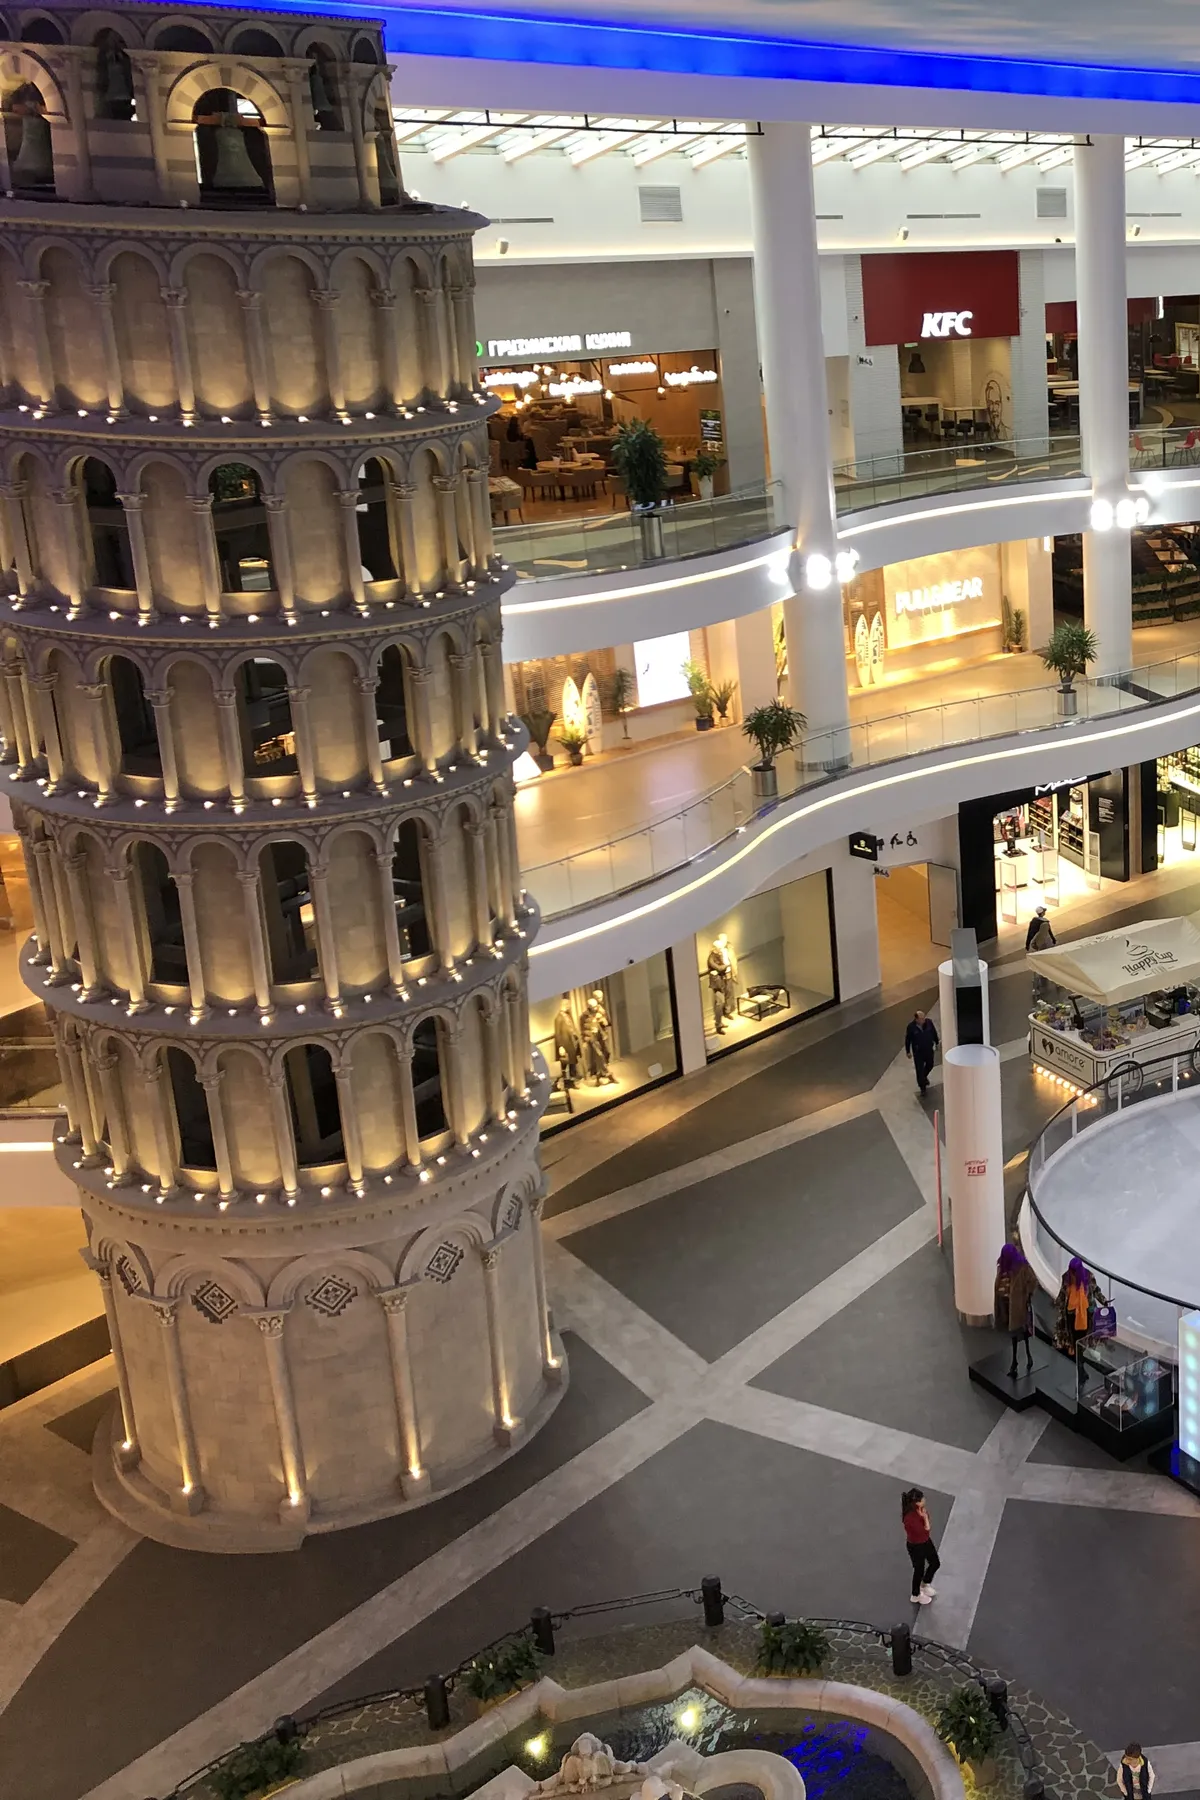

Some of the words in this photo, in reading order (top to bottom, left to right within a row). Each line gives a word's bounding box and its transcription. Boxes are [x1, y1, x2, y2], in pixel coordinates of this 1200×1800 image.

[921, 311, 973, 338] KFC
[488, 335, 581, 357] ГРУЗИНСКАЯ
[585, 331, 631, 349] КУХНЯ
[895, 577, 983, 614] PULL&BEAR
[1121, 956, 1158, 976] Happy
[1154, 951, 1178, 963] Cup
[1055, 1046, 1085, 1068] amore
